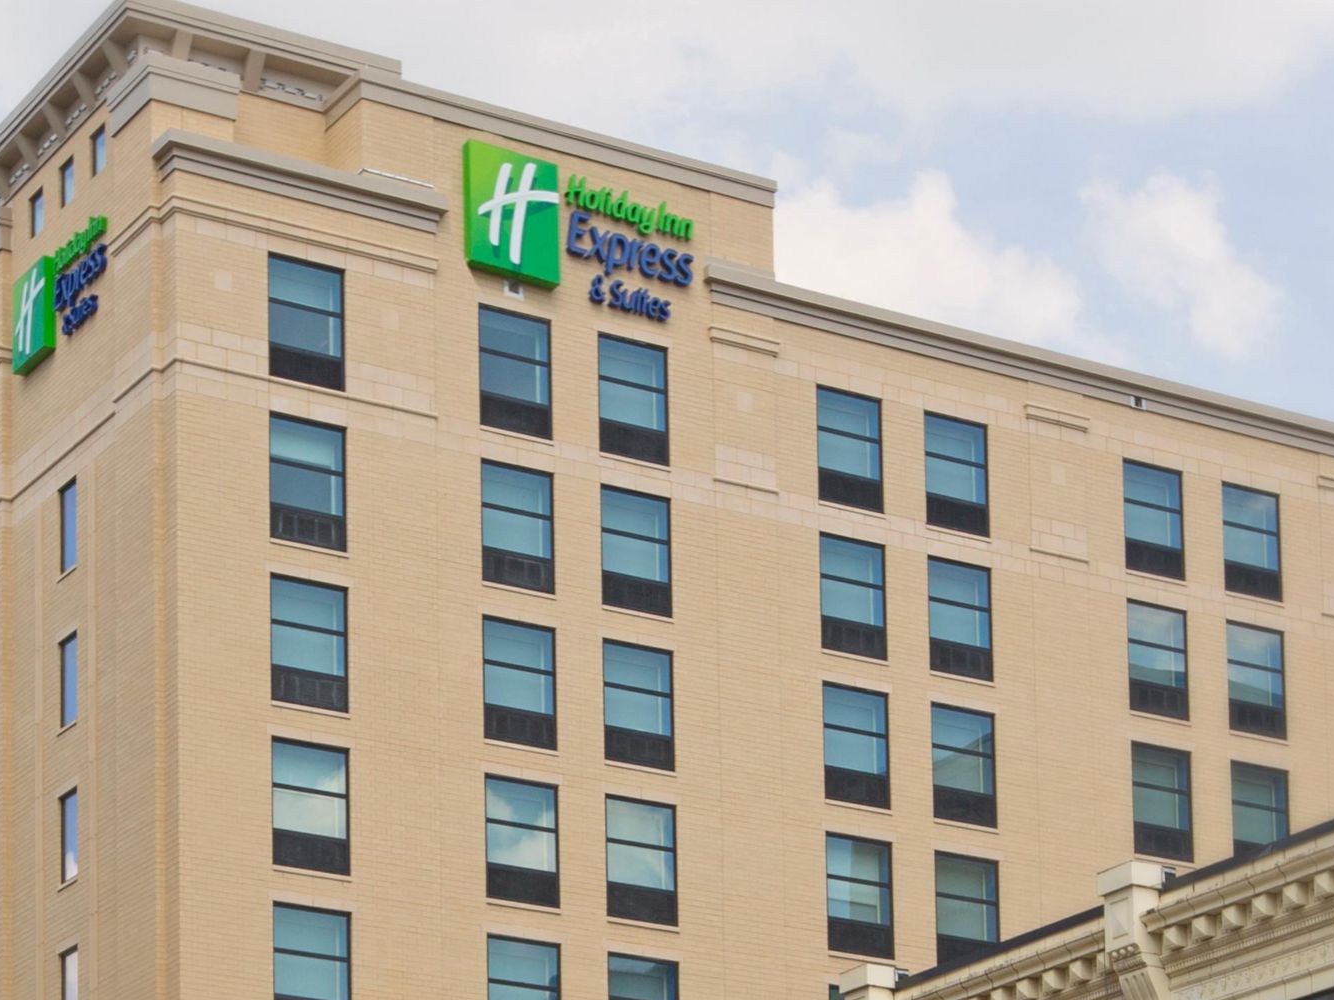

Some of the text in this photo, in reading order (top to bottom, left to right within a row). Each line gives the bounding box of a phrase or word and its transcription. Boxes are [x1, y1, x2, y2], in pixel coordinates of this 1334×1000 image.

[565, 174, 694, 242] Holiday Inn
[53, 244, 108, 312] Express
[566, 210, 695, 287] Express
[588, 274, 672, 322] & Suites
